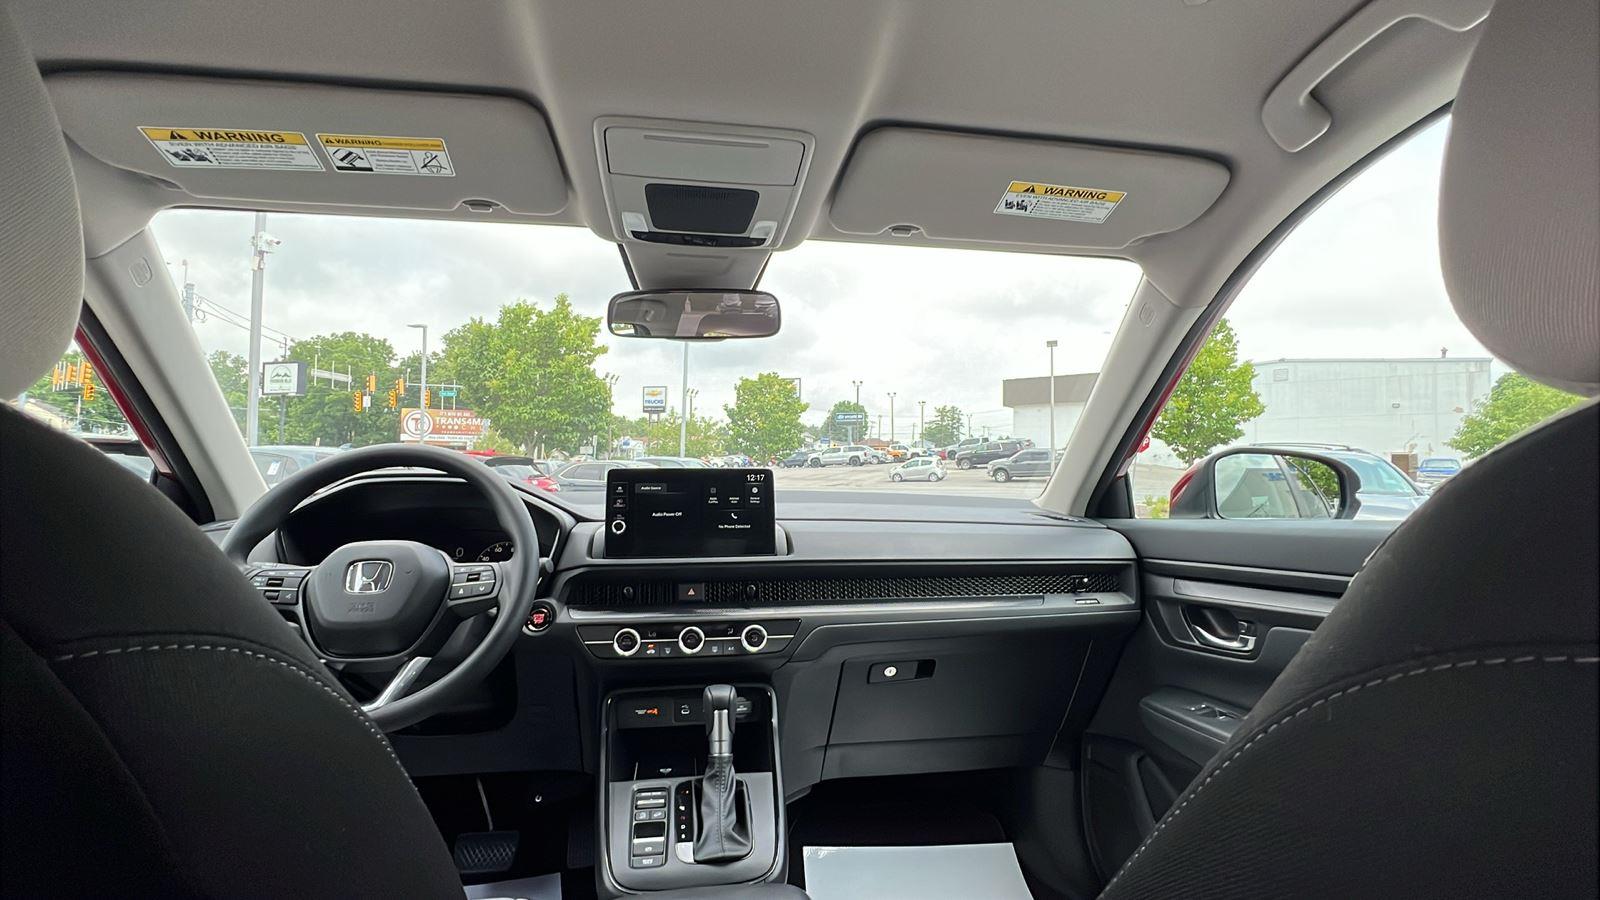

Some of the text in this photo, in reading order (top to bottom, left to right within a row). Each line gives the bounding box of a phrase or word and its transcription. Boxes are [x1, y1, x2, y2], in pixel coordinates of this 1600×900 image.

[192, 130, 285, 143] WARNING
[335, 138, 382, 146] WARNING
[1044, 187, 1107, 199] WARNING
[746, 474, 765, 482] 12:17
